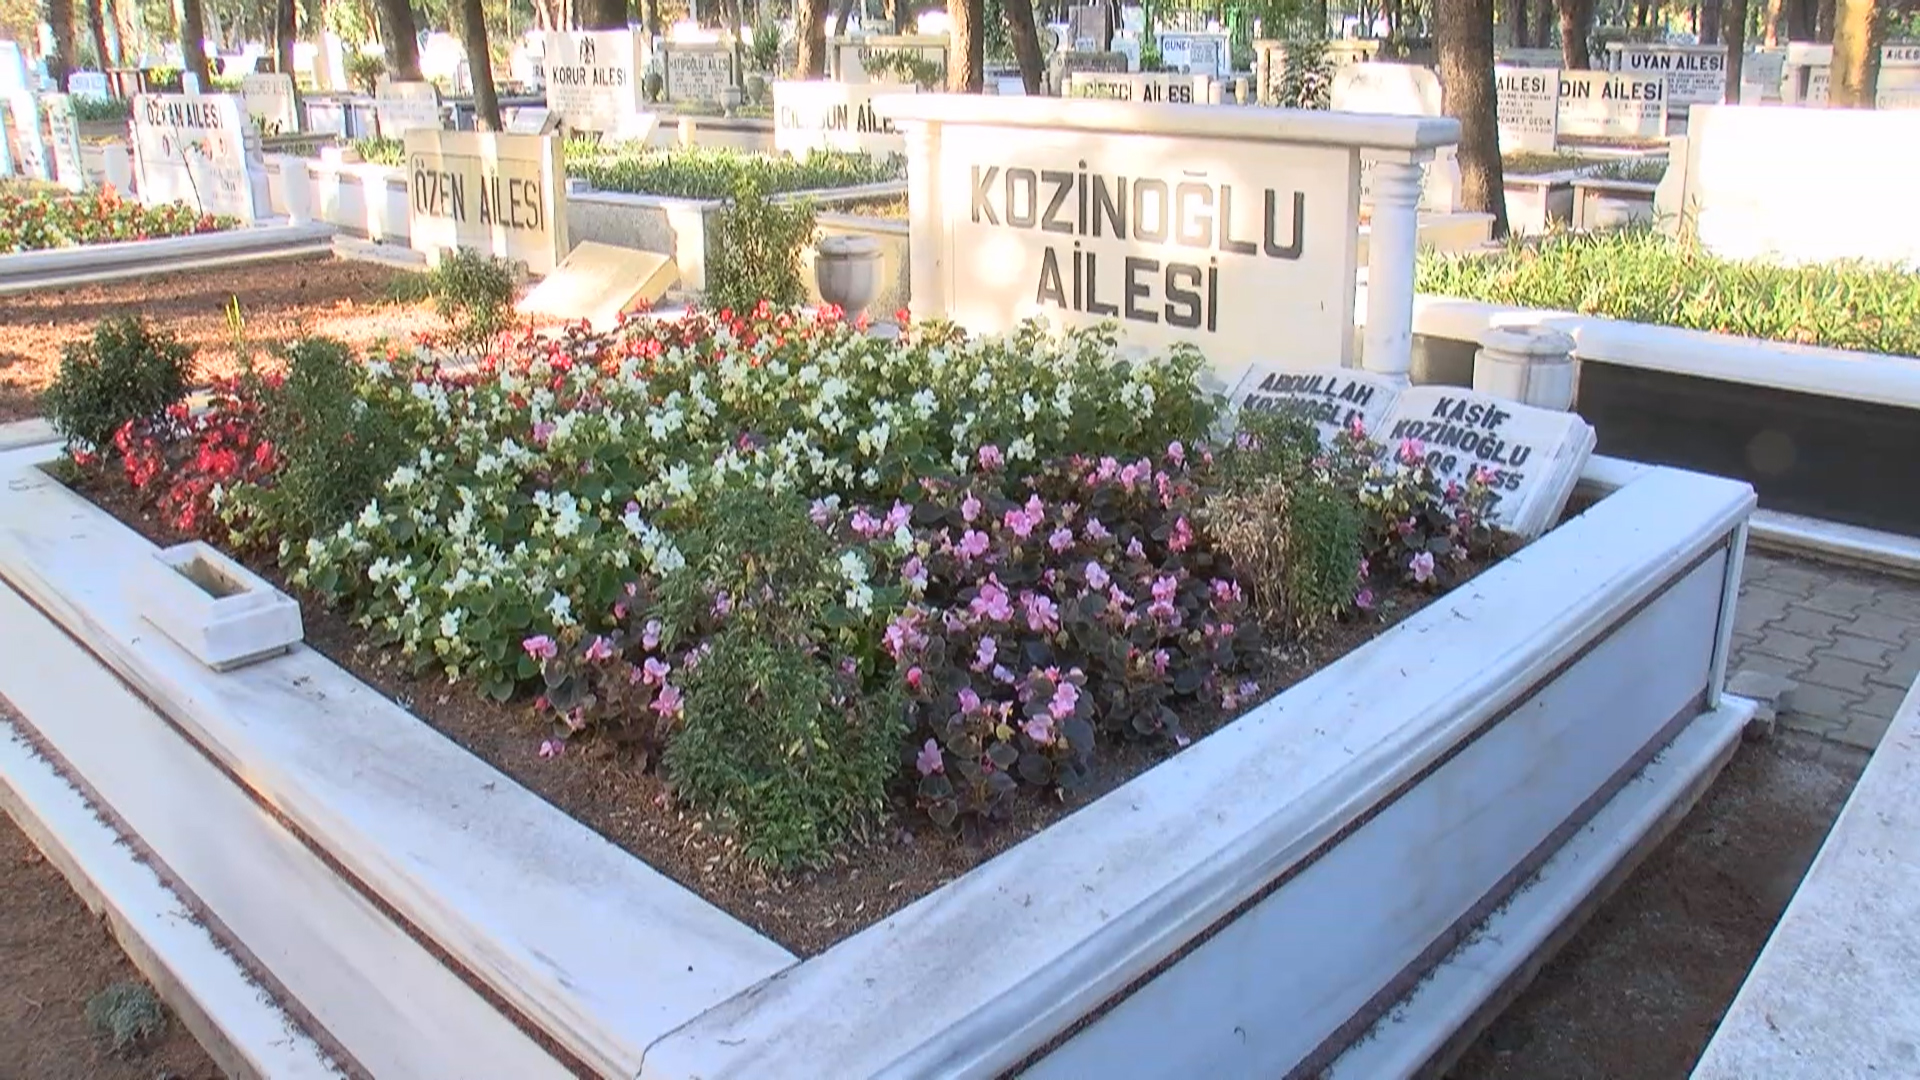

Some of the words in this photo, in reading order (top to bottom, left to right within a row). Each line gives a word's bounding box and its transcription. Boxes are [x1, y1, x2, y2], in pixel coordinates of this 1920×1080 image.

[553, 66, 586, 86] KORUR
[1631, 54, 1670, 70] UYAN
[1602, 76, 1663, 101] AİLESİ
[414, 158, 466, 223] ÖZEN
[480, 166, 544, 232] AİLESİ
[970, 160, 1305, 260] KOZİNOĞLU
[1036, 240, 1218, 332] AİLESİ
[1257, 372, 1375, 406] ABDULLAH
[1431, 397, 1511, 430] KAŞİF
[1389, 418, 1532, 467] KOZİNOĞLU
